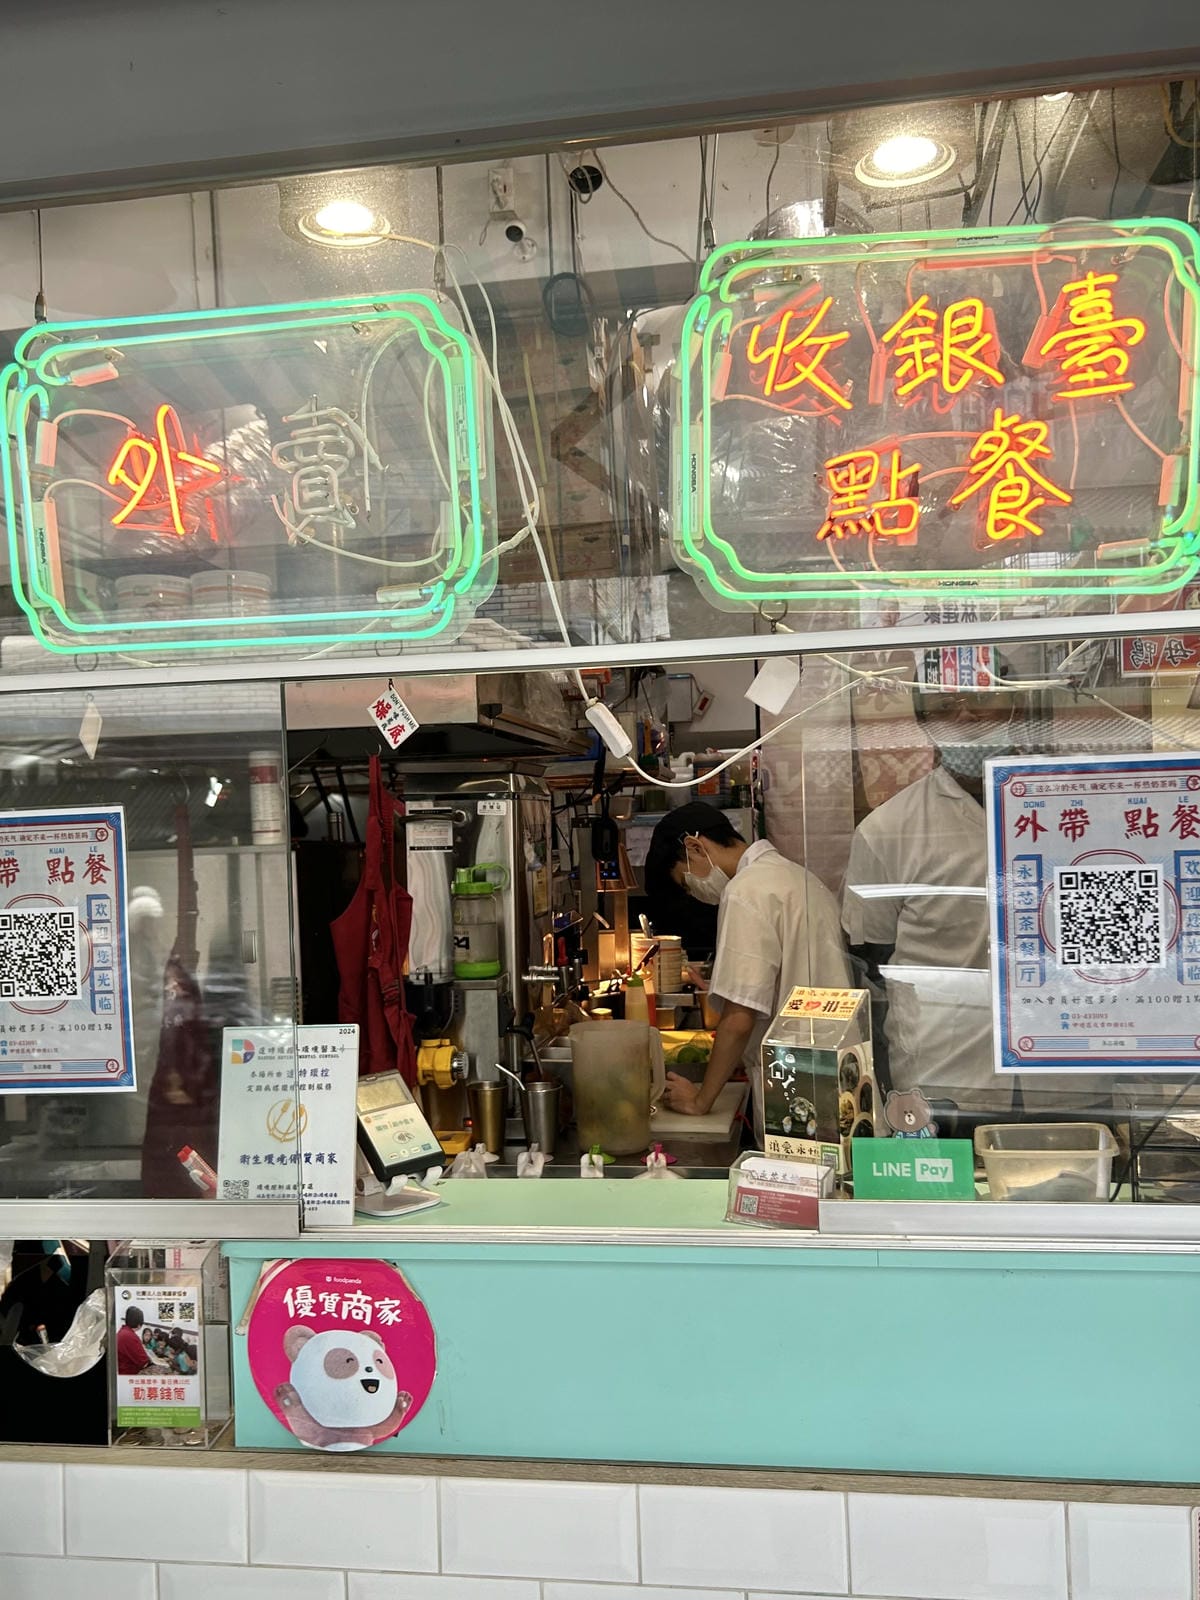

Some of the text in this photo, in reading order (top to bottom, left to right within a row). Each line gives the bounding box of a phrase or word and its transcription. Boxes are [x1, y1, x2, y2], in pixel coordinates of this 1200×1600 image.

[747, 272, 1147, 410] 收銀臺
[816, 408, 1072, 541] 點餐
[1178, 795, 1189, 803] LE
[1014, 804, 1200, 843] 外帶 點餐
[46, 853, 112, 885] 點餐
[872, 1161, 949, 1179] LINE Pay
[333, 1276, 362, 1285] foodpanda
[283, 1284, 403, 1327] 優質商家
